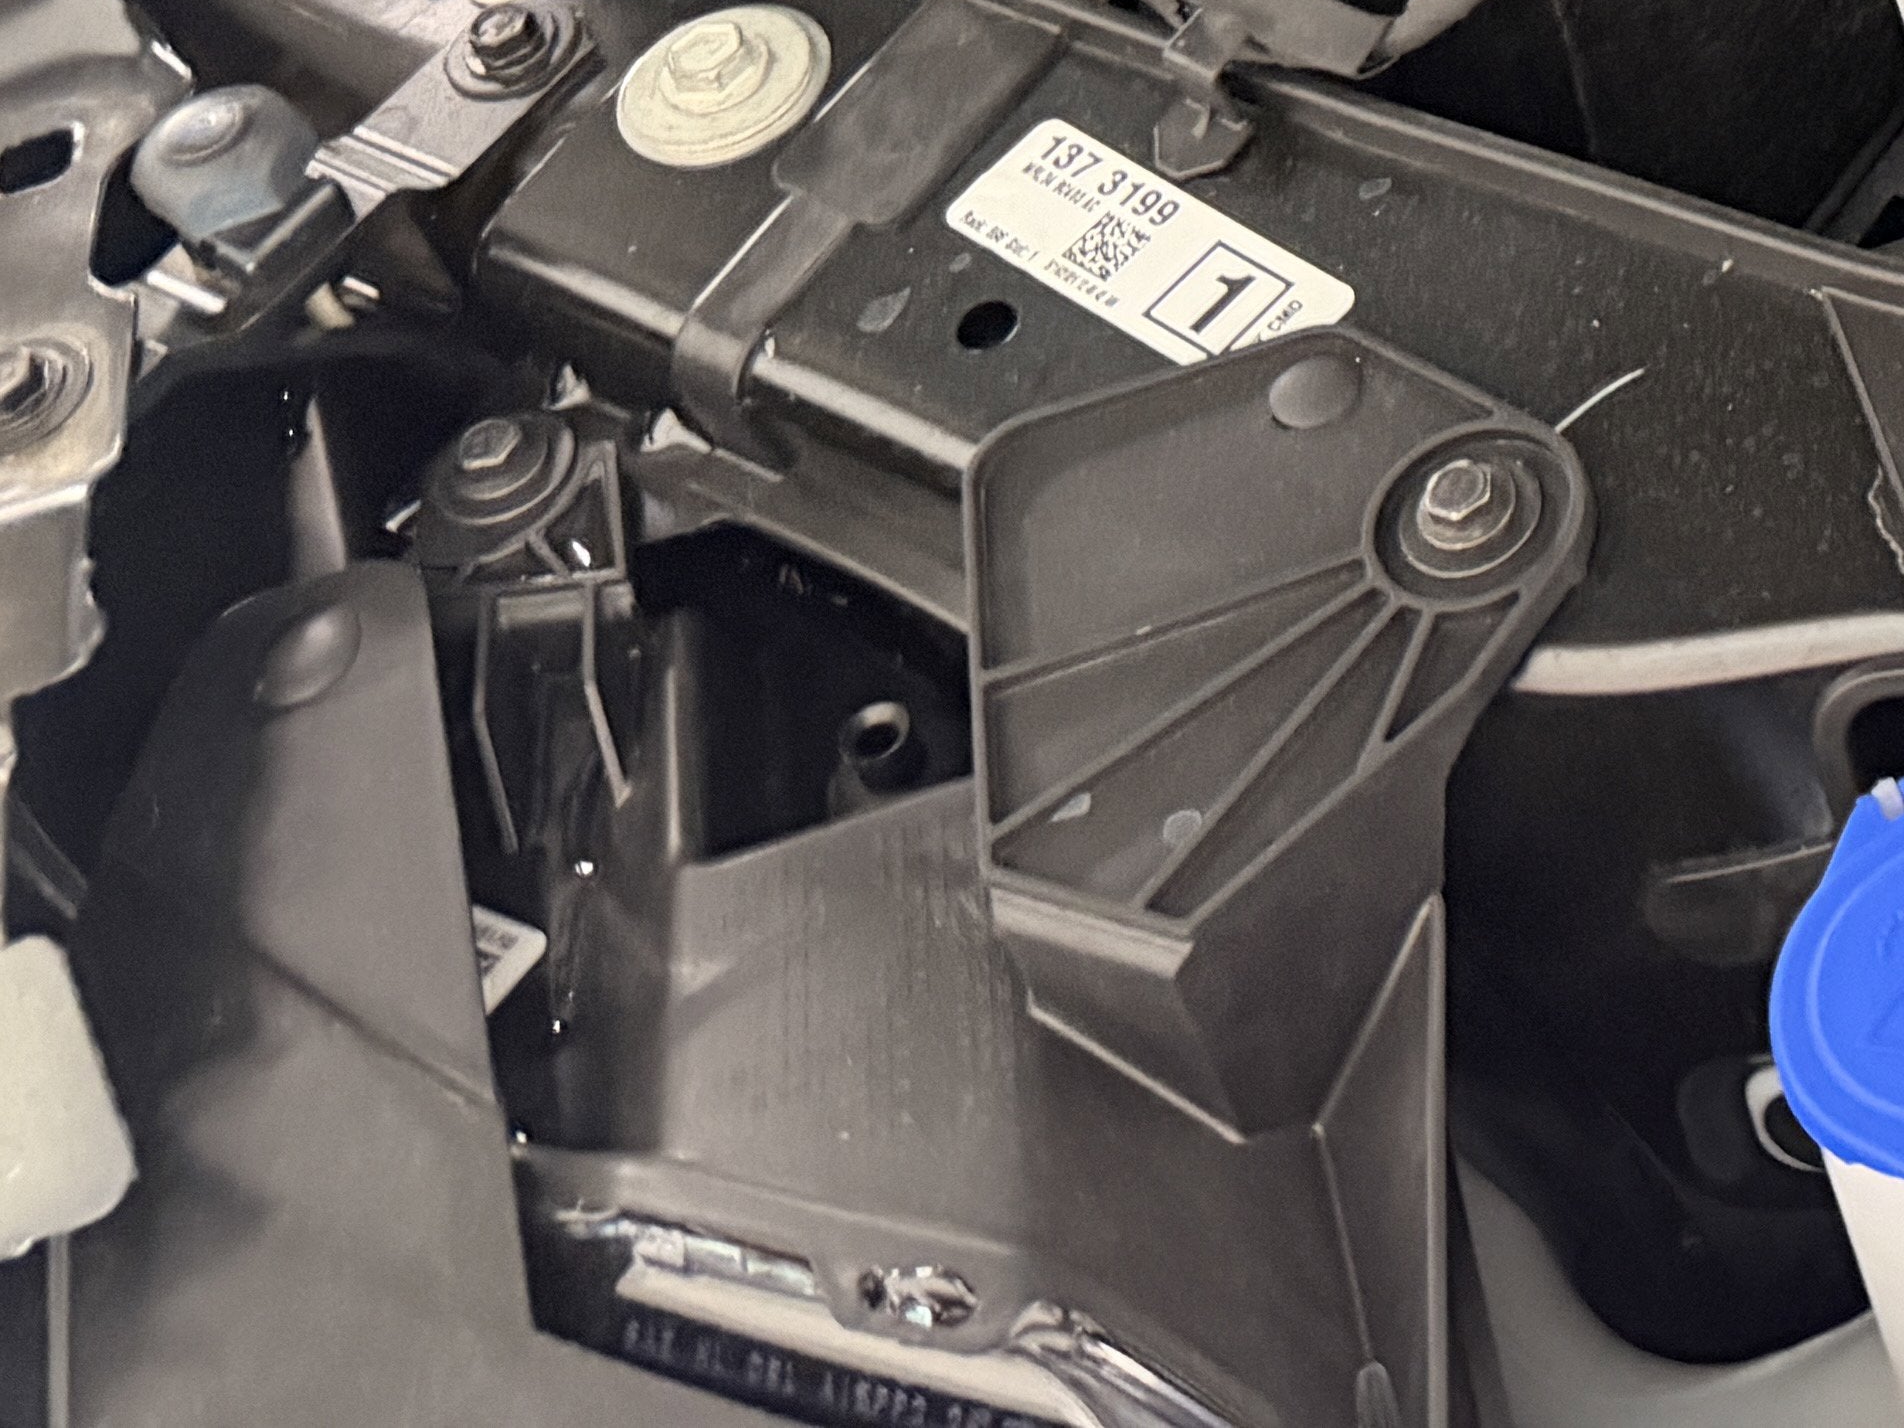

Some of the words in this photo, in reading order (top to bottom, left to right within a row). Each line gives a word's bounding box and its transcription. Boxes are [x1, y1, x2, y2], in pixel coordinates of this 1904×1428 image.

[1039, 133, 1103, 173] 137
[1098, 169, 1182, 227] 3199
[1190, 271, 1258, 335] 1
